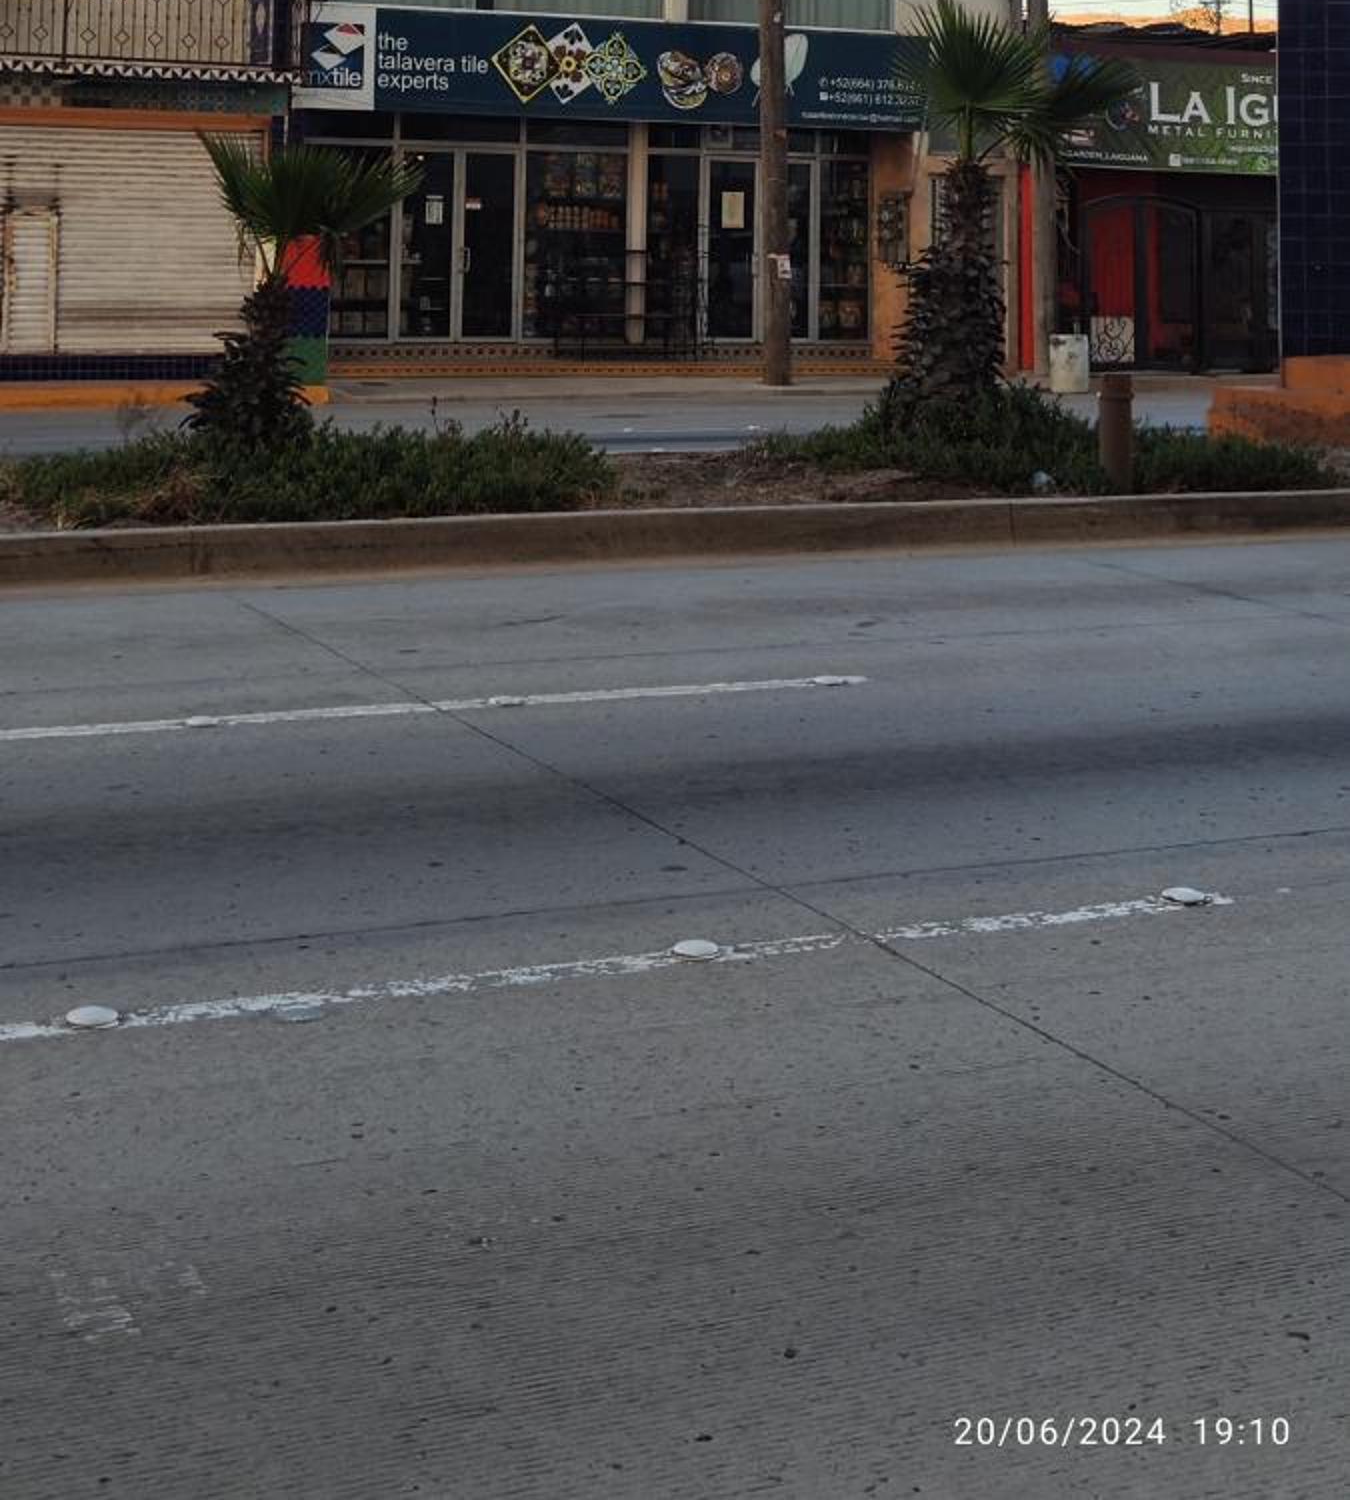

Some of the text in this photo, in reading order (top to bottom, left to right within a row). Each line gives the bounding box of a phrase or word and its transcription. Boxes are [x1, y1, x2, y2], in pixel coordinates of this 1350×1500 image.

[377, 31, 409, 50] the
[377, 51, 490, 73] talavera tile
[377, 72, 450, 93] experts
[1149, 81, 1212, 124] LA
[1147, 124, 1205, 138] METAL
